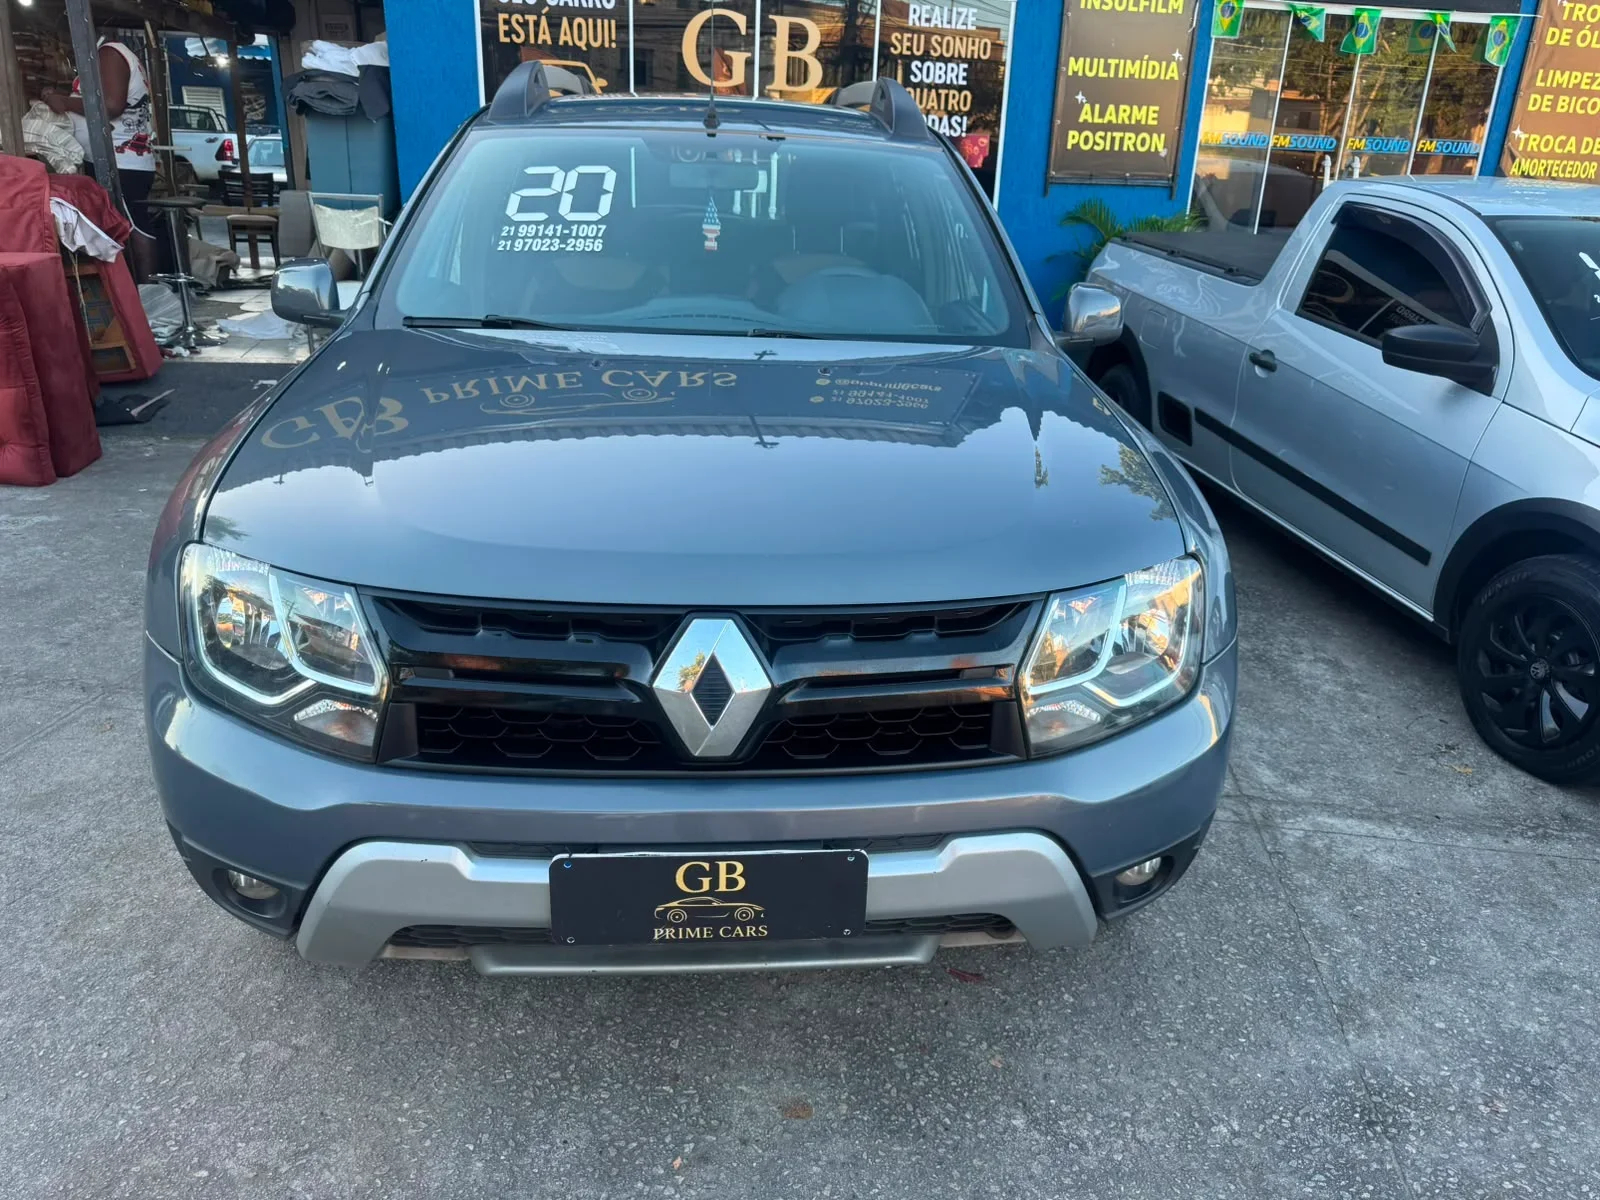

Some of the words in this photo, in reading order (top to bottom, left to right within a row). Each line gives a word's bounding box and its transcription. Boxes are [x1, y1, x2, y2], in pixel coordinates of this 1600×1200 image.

[908, 4, 978, 30] REALIZE
[498, 6, 552, 45] ESTÁ
[558, 16, 617, 51] AQUI!
[1545, 26, 1573, 47] DE
[890, 32, 925, 56] SEU
[930, 34, 992, 60] SONHO
[909, 60, 968, 85] SOBRE
[1067, 55, 1179, 80] MULTIMÍDIA
[1527, 93, 1554, 112] DE
[1078, 103, 1160, 125] ALARME
[1066, 130, 1166, 152] POSITRON
[1518, 133, 1576, 154] TROCA
[1579, 136, 1600, 155] DE
[1510, 158, 1598, 179] AMORTECEDOR
[505, 165, 617, 221] 20
[500, 226, 515, 237] 21
[517, 224, 607, 237] 99141-1007
[497, 240, 511, 251] 21
[513, 238, 604, 251] 97023-2956
[675, 861, 746, 893] GB
[653, 925, 713, 941] PRIME
[719, 924, 768, 939] CARS
